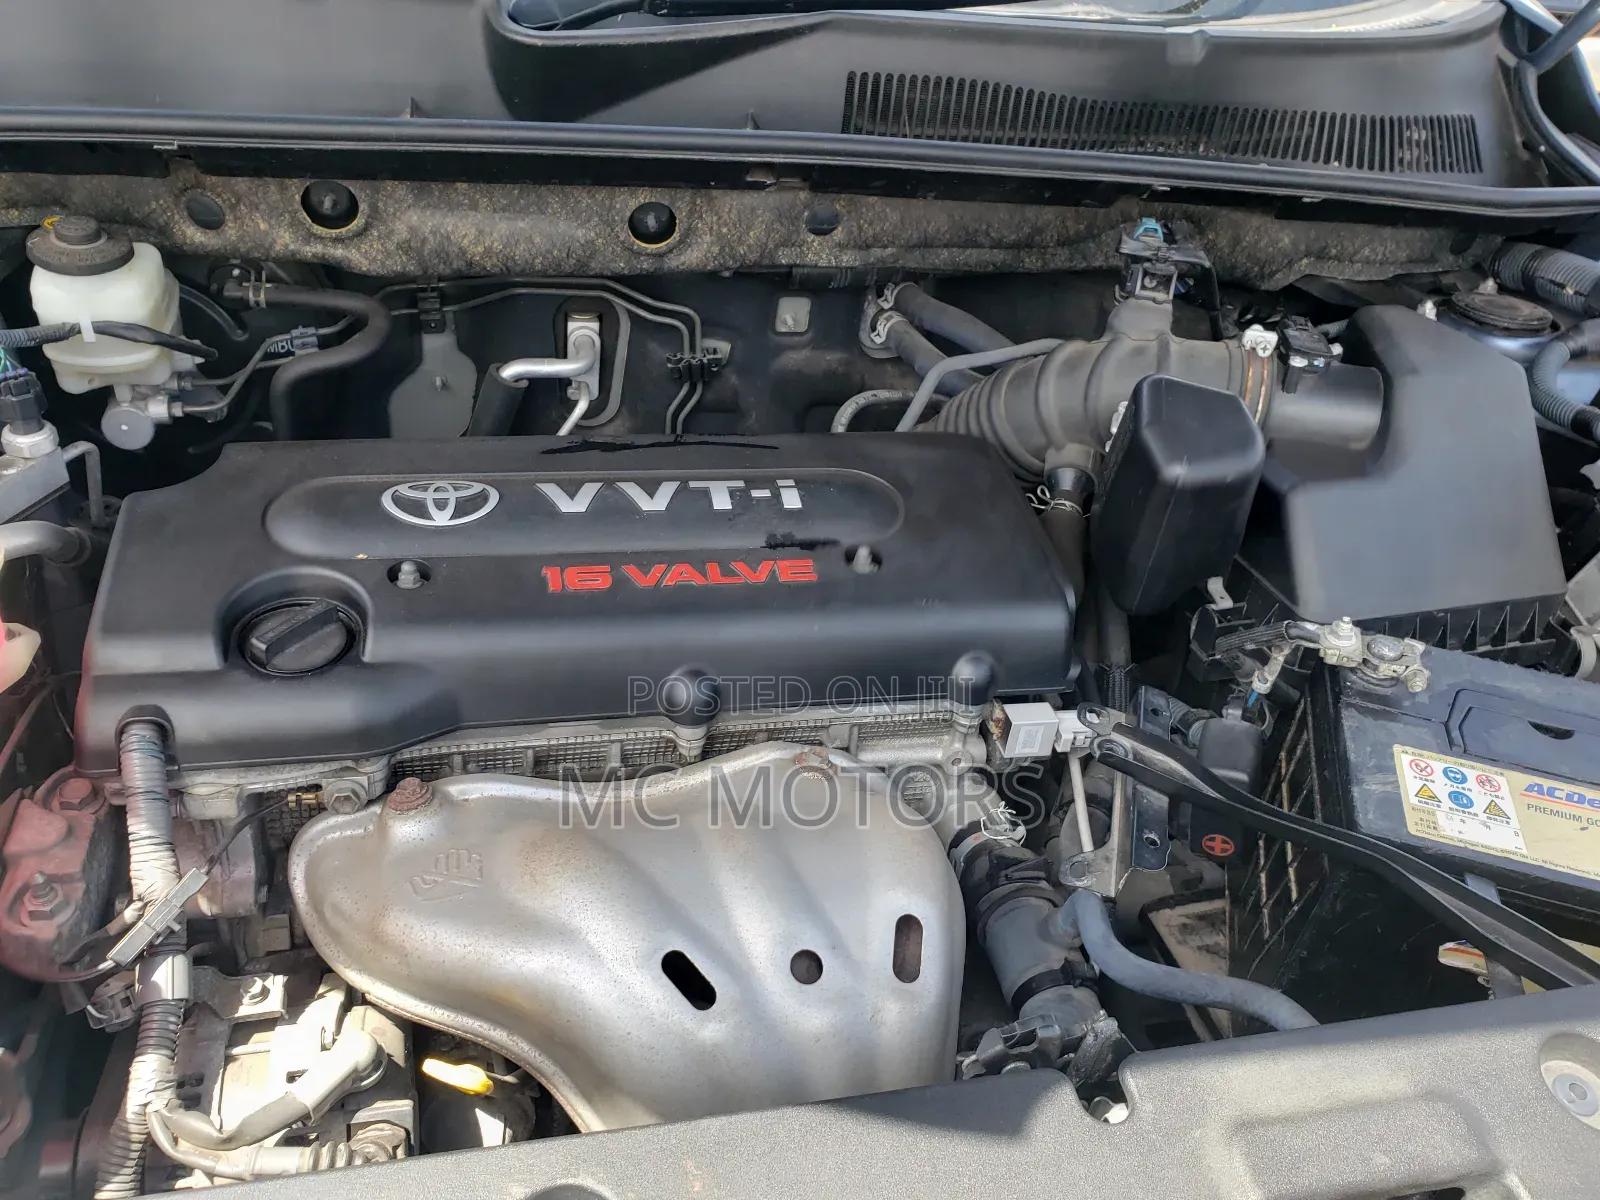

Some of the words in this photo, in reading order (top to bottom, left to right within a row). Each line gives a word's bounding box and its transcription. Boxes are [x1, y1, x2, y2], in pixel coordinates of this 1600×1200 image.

[535, 479, 803, 514] VVT-i
[542, 565, 612, 593] 16
[621, 559, 818, 588] VALVE
[1527, 803, 1583, 824] PREMIUM
